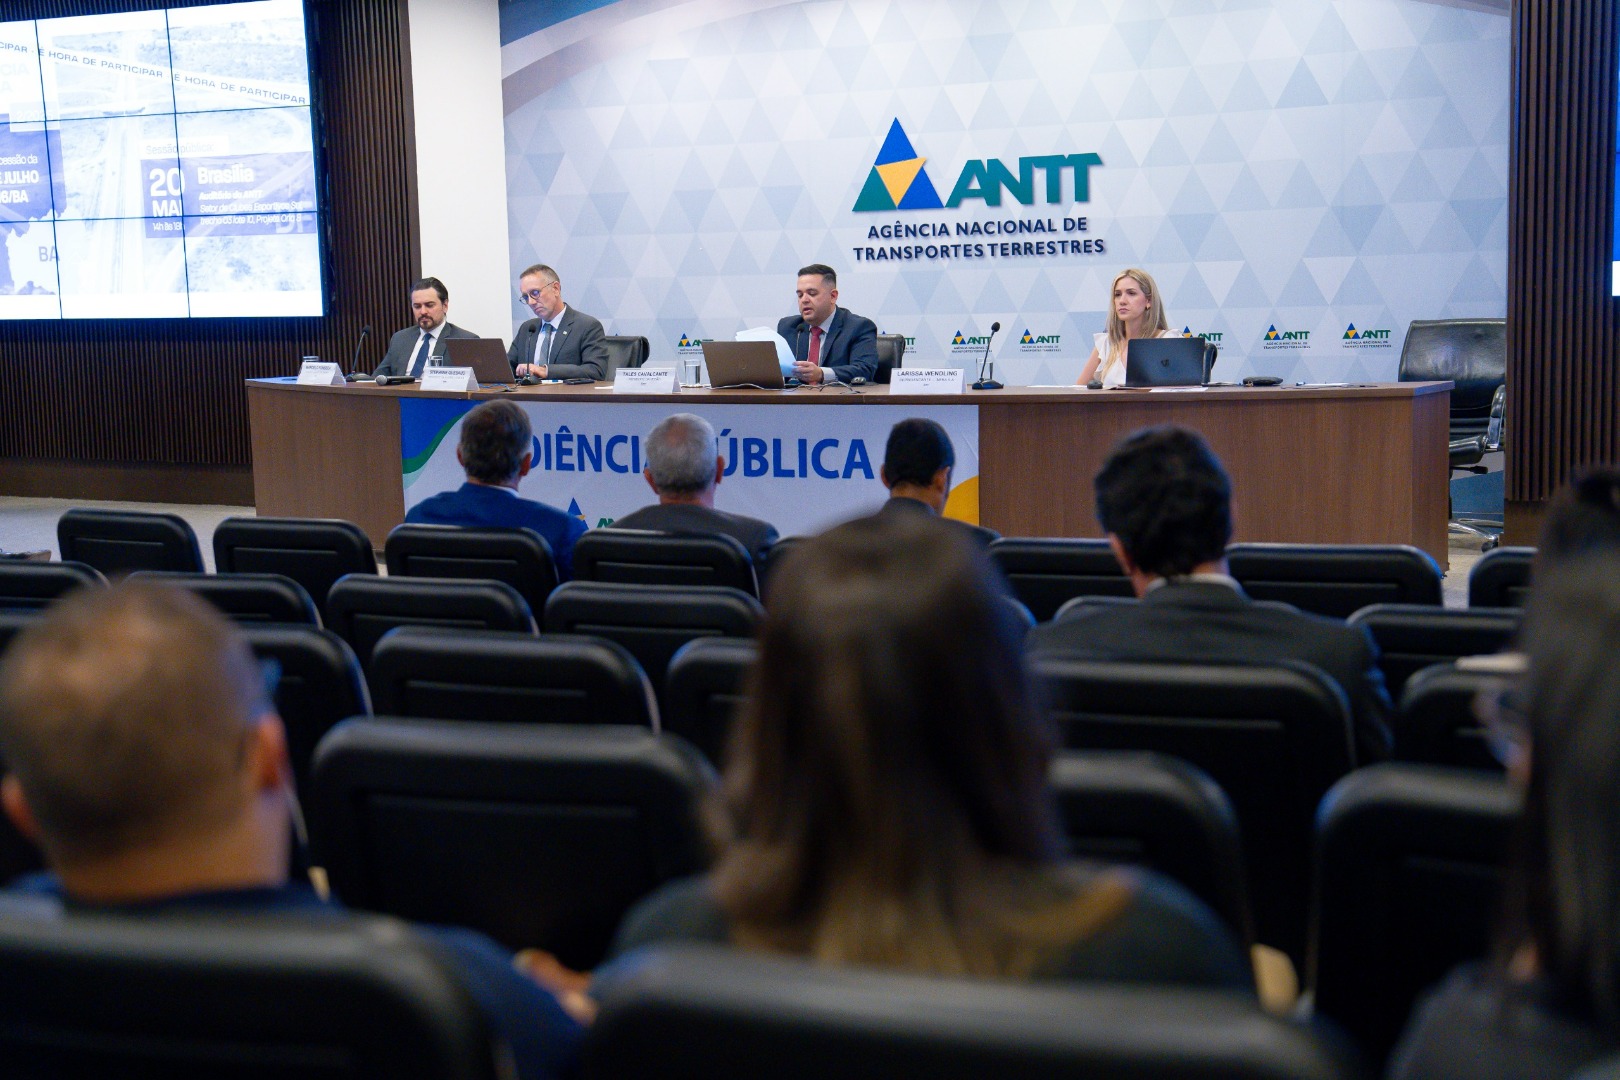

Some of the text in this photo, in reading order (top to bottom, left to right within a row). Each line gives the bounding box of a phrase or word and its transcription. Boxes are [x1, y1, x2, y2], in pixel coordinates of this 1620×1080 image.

[48, 51, 79, 63] HORA
[82, 57, 97, 66] DE
[101, 60, 164, 78] PARTICIPAR
[185, 76, 216, 88] HORA
[220, 82, 236, 92] DE
[239, 86, 306, 105] PARTICIPAR
[28, 153, 38, 164] da
[4, 170, 39, 184] JULHO
[149, 167, 186, 197] 20
[197, 163, 255, 185] Brasília
[944, 152, 1104, 208] ANTT
[867, 216, 1088, 239] AGÊNCIA NACIONAL DE
[38, 246, 61, 262] BA
[852, 239, 1105, 261] TRANSPORTES TERRESTRES
[967, 337, 991, 345] ANTT
[1036, 335, 1061, 344] ANTT
[1281, 331, 1311, 341] ANTT
[1361, 329, 1392, 340] ANTT
[716, 428, 875, 479] ÚBLICA
